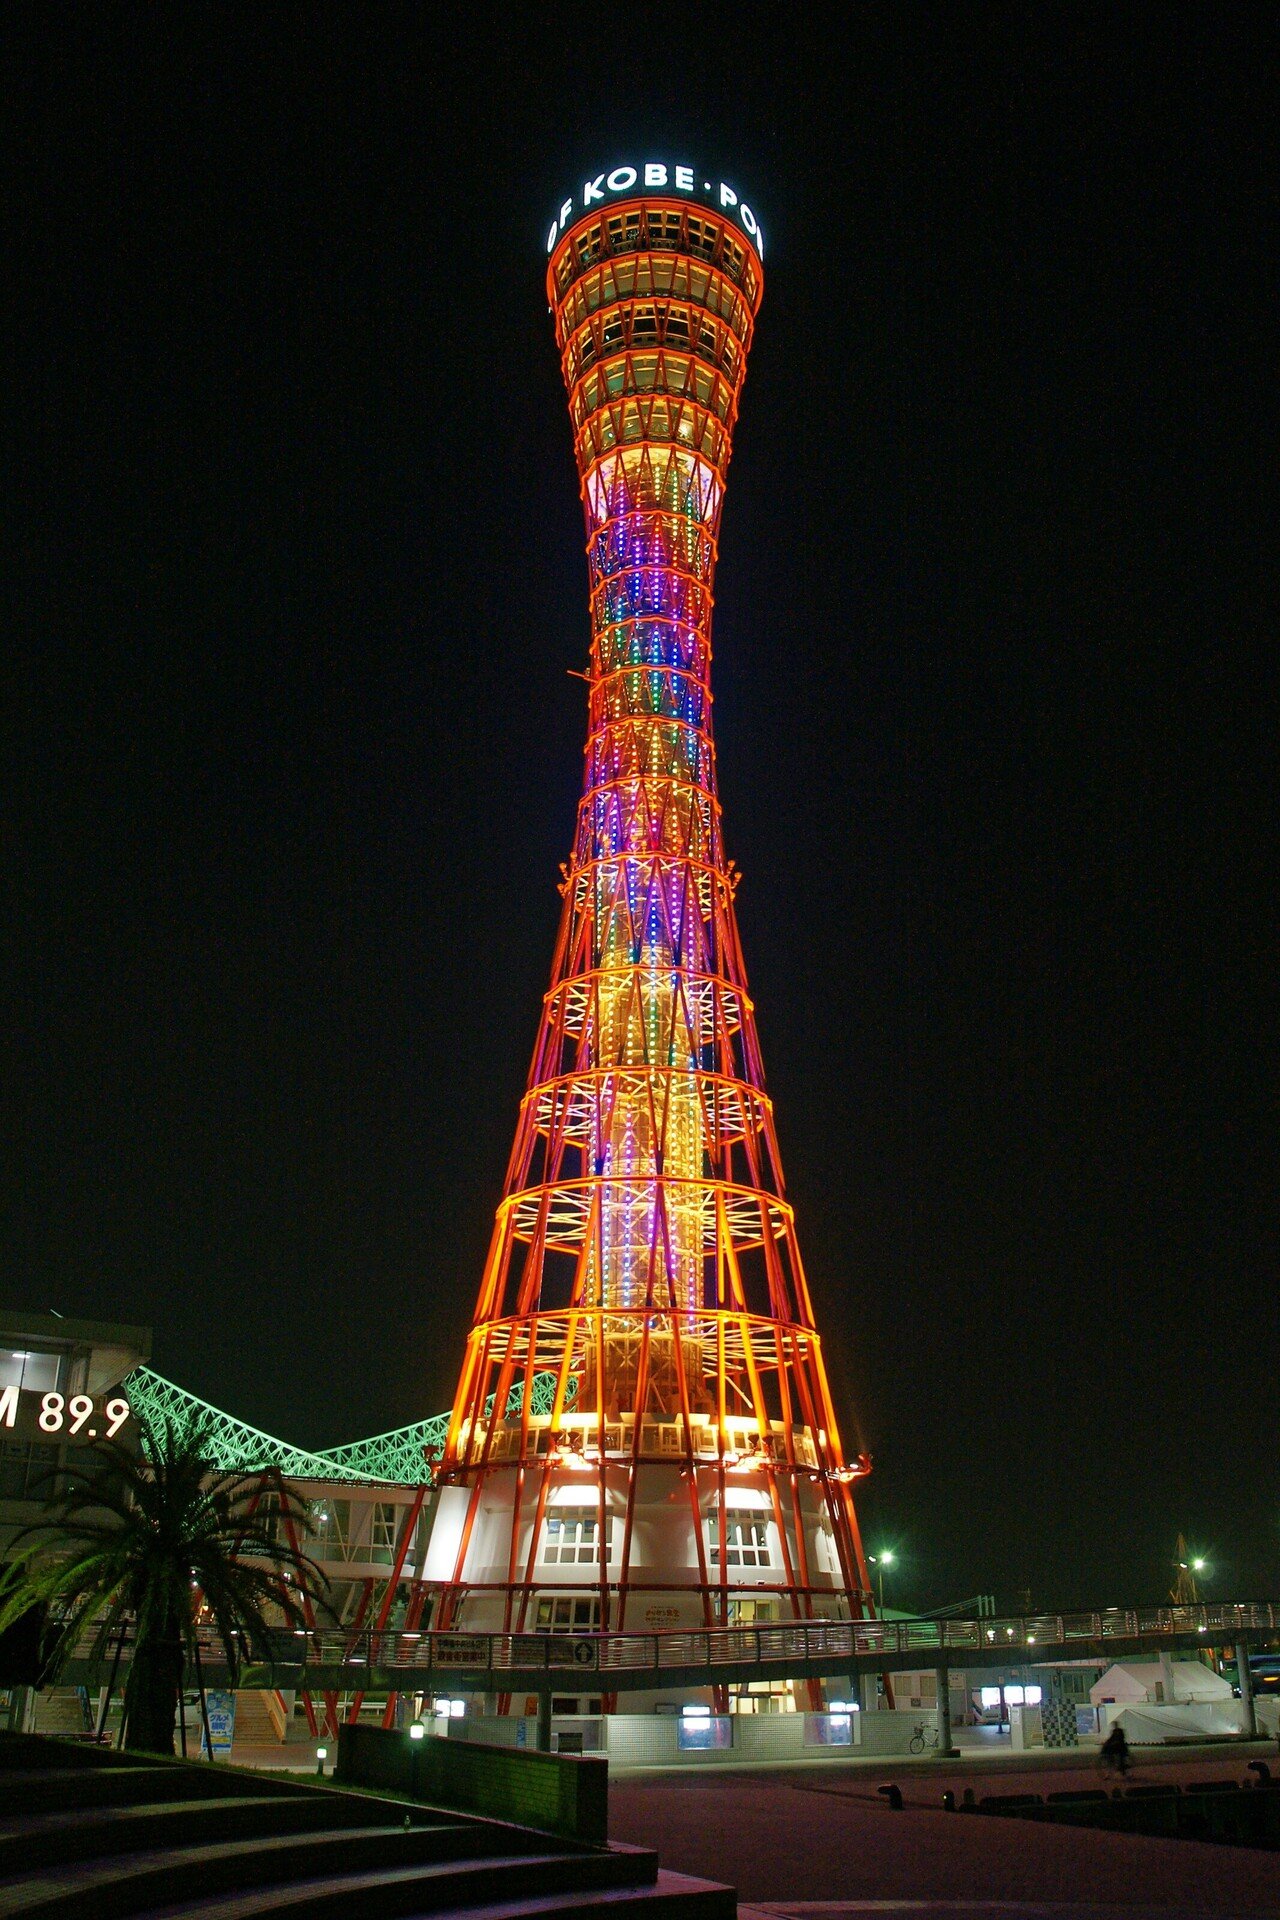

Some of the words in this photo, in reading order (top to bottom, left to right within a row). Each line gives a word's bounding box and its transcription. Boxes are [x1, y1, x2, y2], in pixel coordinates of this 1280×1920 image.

[547, 198, 572, 252] OF
[584, 163, 695, 206] KOBE
[39, 1392, 130, 1438] 89.9
